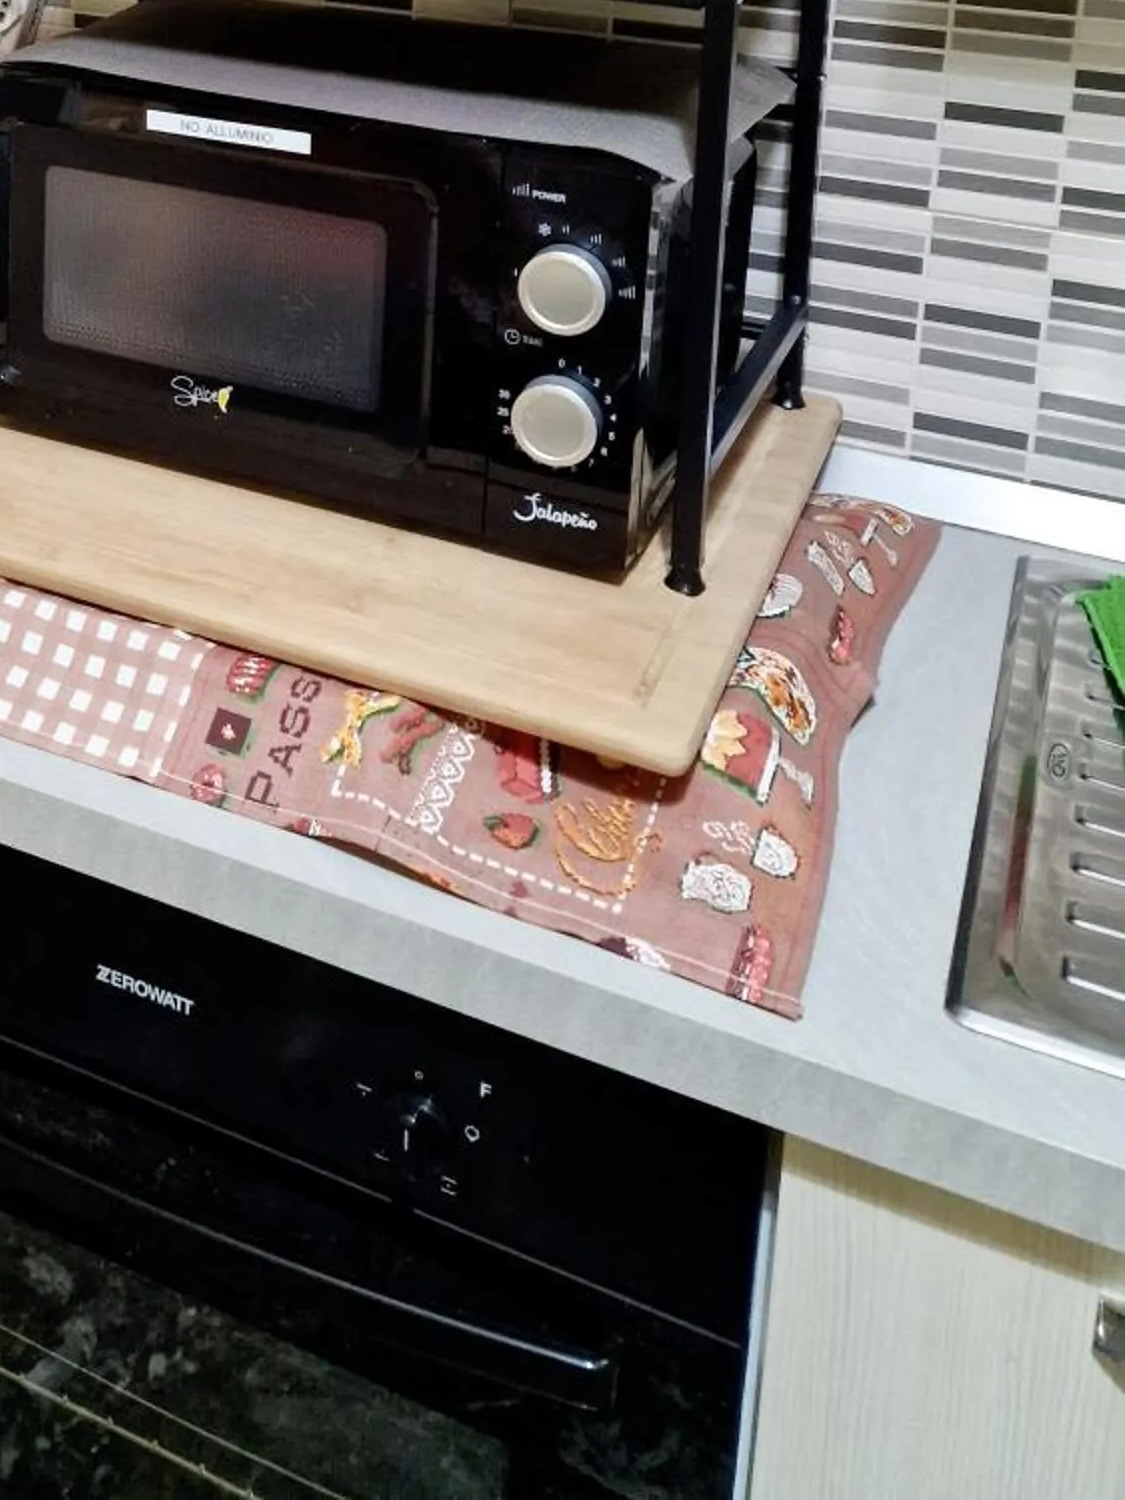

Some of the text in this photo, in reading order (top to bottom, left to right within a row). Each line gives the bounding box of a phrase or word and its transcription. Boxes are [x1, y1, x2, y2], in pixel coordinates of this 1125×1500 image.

[179, 119, 275, 145] NO ALLUMINIO
[532, 189, 566, 204] POWER
[514, 492, 598, 530] Jalapeño
[96, 963, 195, 1016] ZEROWATT
